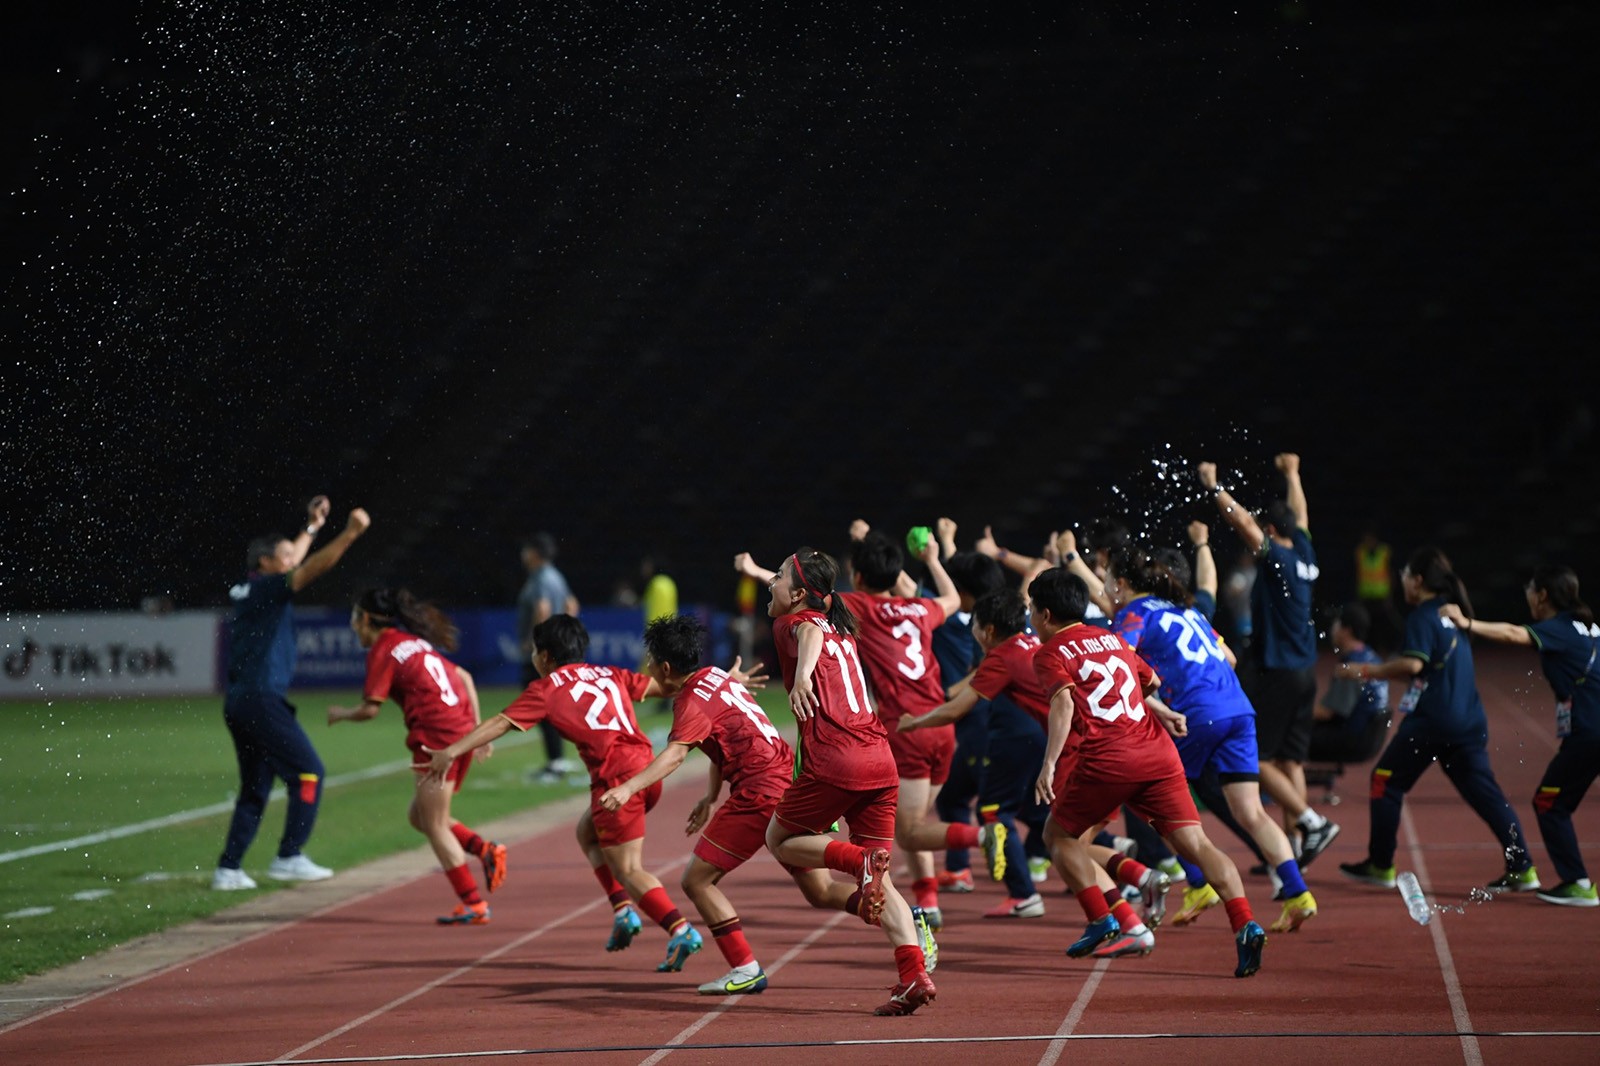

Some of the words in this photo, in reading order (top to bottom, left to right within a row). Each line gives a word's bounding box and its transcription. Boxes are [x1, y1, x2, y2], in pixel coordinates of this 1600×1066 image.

[48, 642, 177, 677] TikTok
[424, 653, 459, 707] 9
[824, 638, 873, 714] 11
[892, 619, 926, 681] 3
[568, 676, 635, 735] 21
[1078, 654, 1146, 723] 22
